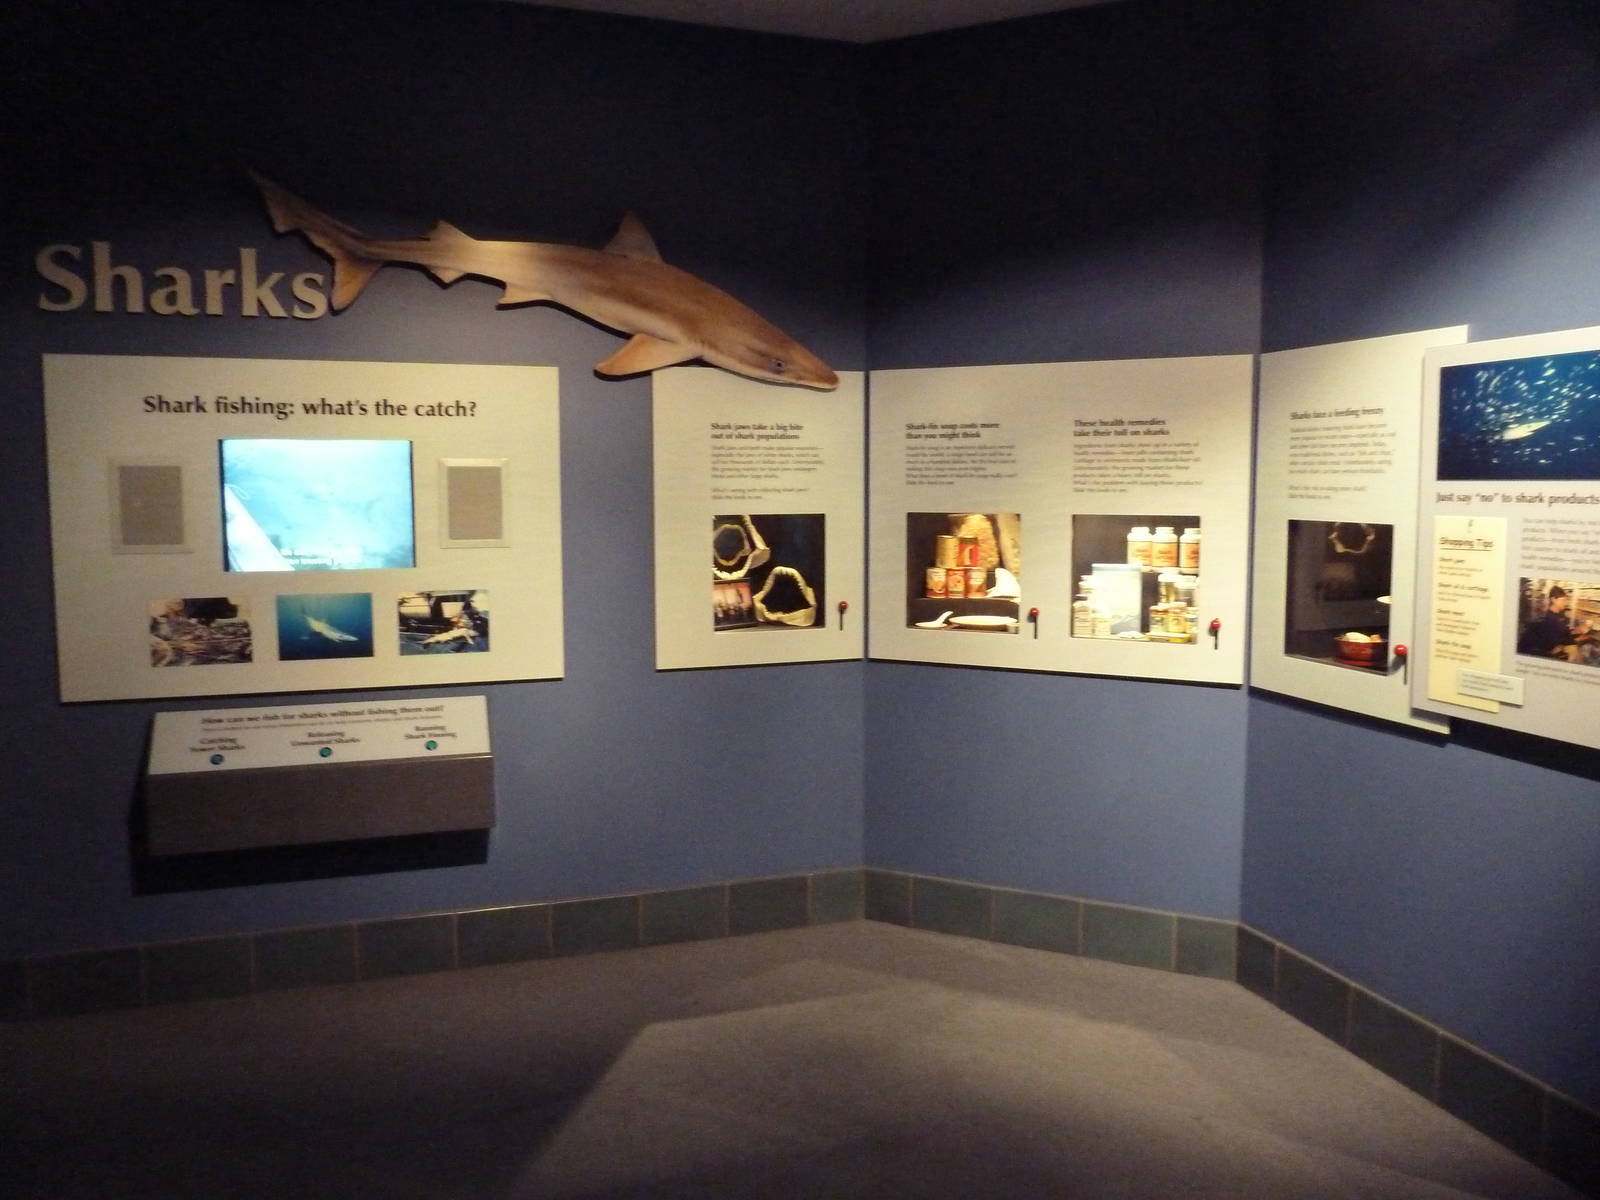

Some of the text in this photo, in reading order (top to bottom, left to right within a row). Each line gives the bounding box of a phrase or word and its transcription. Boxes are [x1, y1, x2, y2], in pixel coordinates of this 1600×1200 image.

[35, 241, 328, 319] Sharks
[143, 395, 477, 421] Shark fishing: what's the catch?
[1436, 491, 1455, 503] Just
[1456, 493, 1472, 505] say
[1502, 492, 1513, 503] to
[1515, 492, 1545, 504] shark
